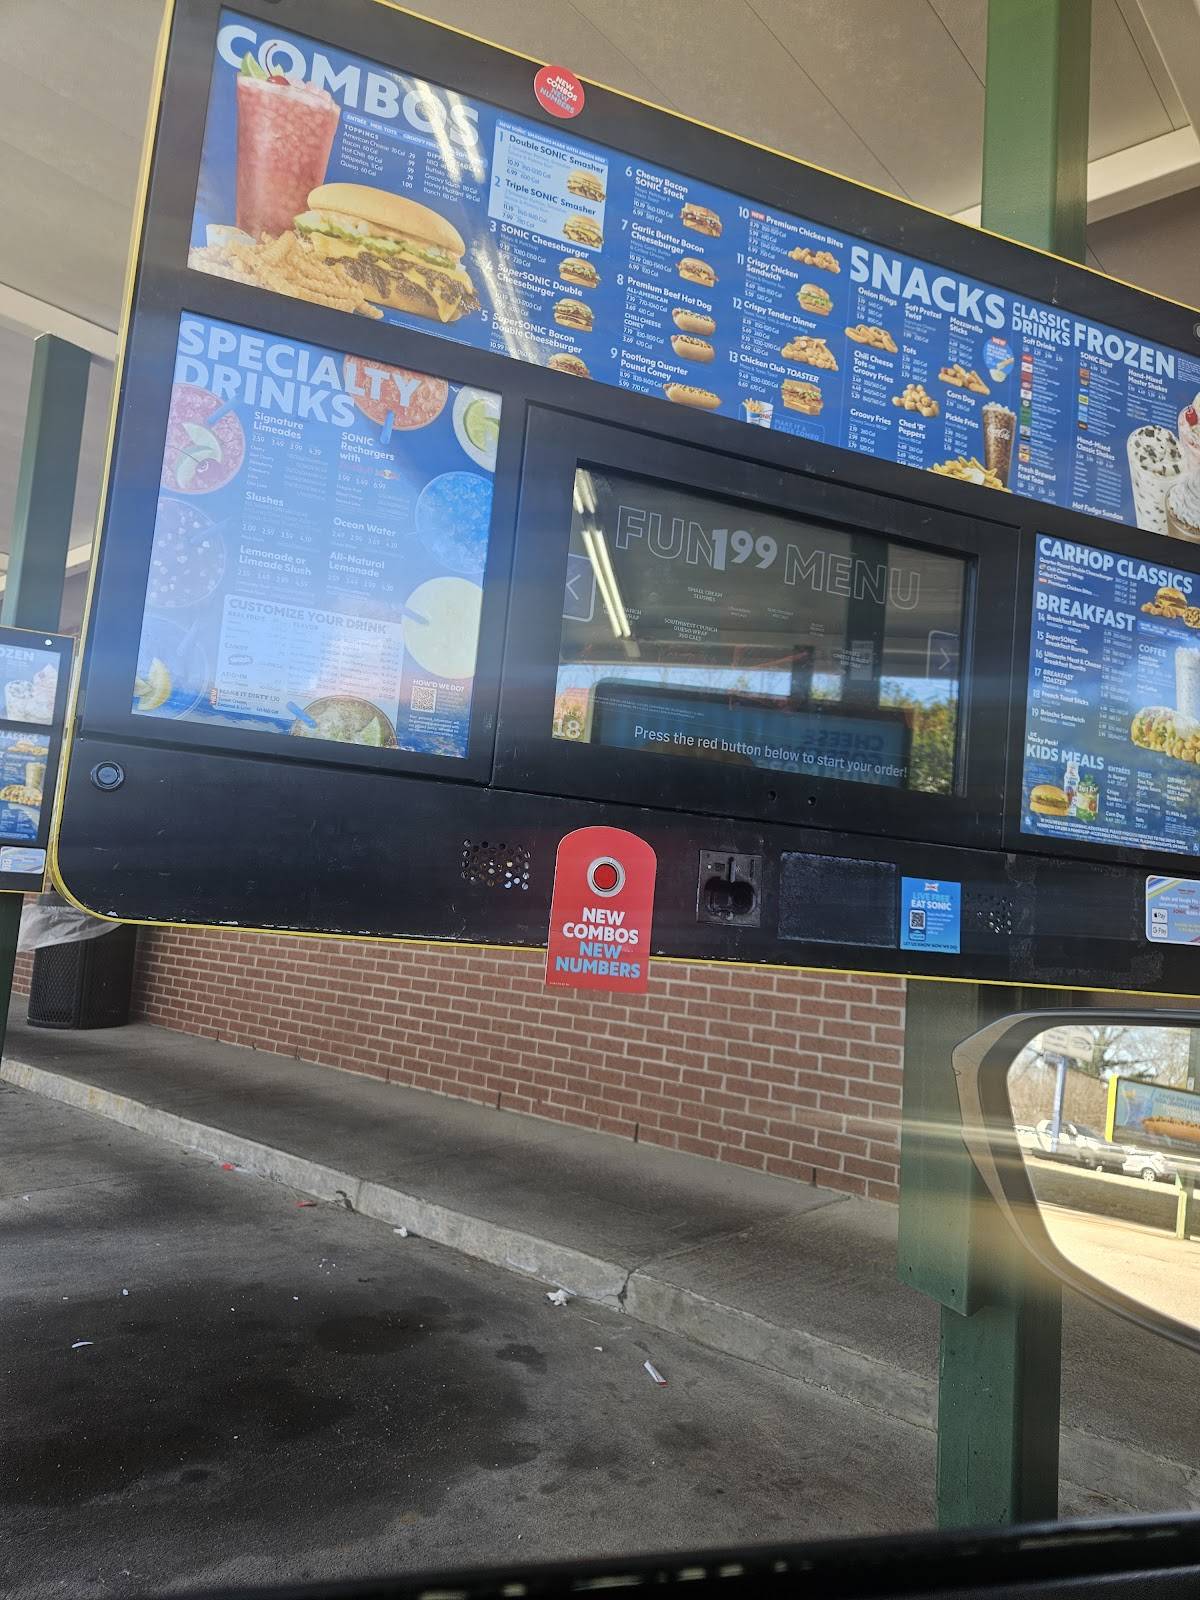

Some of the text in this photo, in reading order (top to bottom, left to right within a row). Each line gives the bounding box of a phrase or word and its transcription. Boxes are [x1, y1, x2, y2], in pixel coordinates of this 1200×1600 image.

[217, 25, 479, 146] COMBOS
[547, 78, 577, 101] COMBOS
[556, 76, 574, 91] NEW
[540, 88, 574, 113] NUMBERS
[344, 124, 379, 140] TOPPINGS
[342, 138, 360, 149] Bacon
[500, 132, 503, 141] 1
[509, 135, 539, 151] Double
[540, 146, 568, 161] SONIC
[569, 157, 604, 174] Smasher
[625, 167, 688, 193] 6 Cheesy Bacon
[635, 176, 661, 192] SONIC
[663, 187, 685, 200] Stack
[494, 176, 500, 187] 2
[505, 179, 529, 194] Triple
[531, 189, 558, 204] SONIC
[560, 199, 596, 215] Smasher
[621, 219, 628, 230] 7
[632, 222, 655, 236] Garlic
[656, 231, 681, 244] Butter
[681, 240, 704, 253] Bacon
[739, 206, 844, 248] 10 Premium Chicken Bites
[489, 221, 497, 232] 3
[501, 224, 529, 239] SONIC
[532, 233, 589, 259] Cheeseburger
[631, 231, 684, 255] Cheeseburger
[737, 253, 798, 279] 11 Crispy Chicken
[746, 265, 782, 281] Sandwich
[497, 263, 583, 297] SuperSONIC Double
[497, 273, 555, 298] Cheeseburger
[850, 246, 1005, 329] SNACKS
[617, 274, 712, 312] 8 Premium Beef Hot Dog
[627, 287, 668, 304] ALL-AMERICAN
[858, 286, 897, 306] Onion Rings
[733, 297, 742, 310] 12
[744, 301, 767, 314] Crispy
[768, 308, 792, 321] Tender
[792, 315, 816, 329] Dinner
[905, 302, 942, 320] Soft Pretzel
[905, 311, 922, 321] Twist
[1012, 302, 1070, 330] CLASSIC
[481, 310, 575, 343] 5 SuperSONIC Bacon
[624, 313, 661, 328] CHILI CHEESE
[624, 319, 645, 329] CONEY
[492, 322, 582, 353] Double Cheeseburger
[950, 325, 968, 336] Sticks
[1012, 315, 1071, 347] DRINKS
[902, 345, 917, 356] Tots
[1023, 336, 1056, 351] Soft Drinks
[1074, 322, 1175, 379] FROZEN
[180, 320, 422, 408] SPECIALTY
[610, 348, 688, 376] 9 Footlong Quarter
[854, 350, 894, 368] Chili Cheese
[854, 358, 868, 367] Tots
[1080, 351, 1099, 363] SONIC
[620, 360, 672, 381] Pound Coney
[729, 350, 738, 363] 13
[740, 354, 768, 369] Chicken
[769, 363, 785, 374] Club
[787, 368, 820, 383] TOASTER
[853, 366, 894, 383] Groovy Fries
[173, 355, 356, 428] DRINKS
[946, 390, 976, 406] Corn Dog
[254, 411, 304, 430] Signature
[850, 409, 892, 425] Groovy Fries
[899, 419, 916, 428] Ched
[945, 412, 979, 429] Pickle Fries
[253, 421, 301, 440] Limeades
[341, 432, 374, 446] SONIC
[898, 426, 925, 439] Peppers
[340, 442, 395, 461] Rechargers
[340, 452, 361, 464] with
[246, 491, 283, 507] Slushes
[1072, 501, 1084, 513] Hot
[334, 517, 364, 529] Ocean
[367, 523, 396, 536] Water
[240, 545, 293, 562] Lemonade
[330, 552, 385, 569] All-Natural
[615, 505, 714, 569] FUN
[783, 543, 922, 611] MENU
[239, 554, 311, 576] Limeade Slush
[329, 560, 379, 578] Lemonade
[1040, 538, 1114, 571] CARHOP
[1117, 559, 1193, 594] CLASSICS
[687, 586, 705, 595] SMALL
[229, 598, 387, 634] CUSTOMIZE YOUR DRINK
[1035, 592, 1136, 632] BREAKFAST
[1038, 612, 1072, 625] 14 Breakfast
[664, 617, 696, 629] SOUTHWEST
[673, 625, 708, 636] QUESO WRAP
[1037, 630, 1078, 645] 15 SuperSONIC
[1035, 649, 1043, 658] 16
[1139, 644, 1167, 658] COFFEE
[1034, 667, 1073, 680] 17 BREAKFAST
[413, 680, 437, 688] HOW'D
[1033, 689, 1059, 700] 18 French
[1032, 707, 1085, 723] 19 Sandwich
[634, 725, 908, 778] Press the red button below to start your order!
[1026, 743, 1105, 770] KIDS MEALS
[911, 900, 951, 911] EAT SONIC
[582, 907, 625, 926] NEW
[1157, 912, 1166, 920] Pay
[562, 922, 639, 944] COMBOS
[579, 941, 623, 959] NEW
[555, 956, 641, 979] NUMBERS
